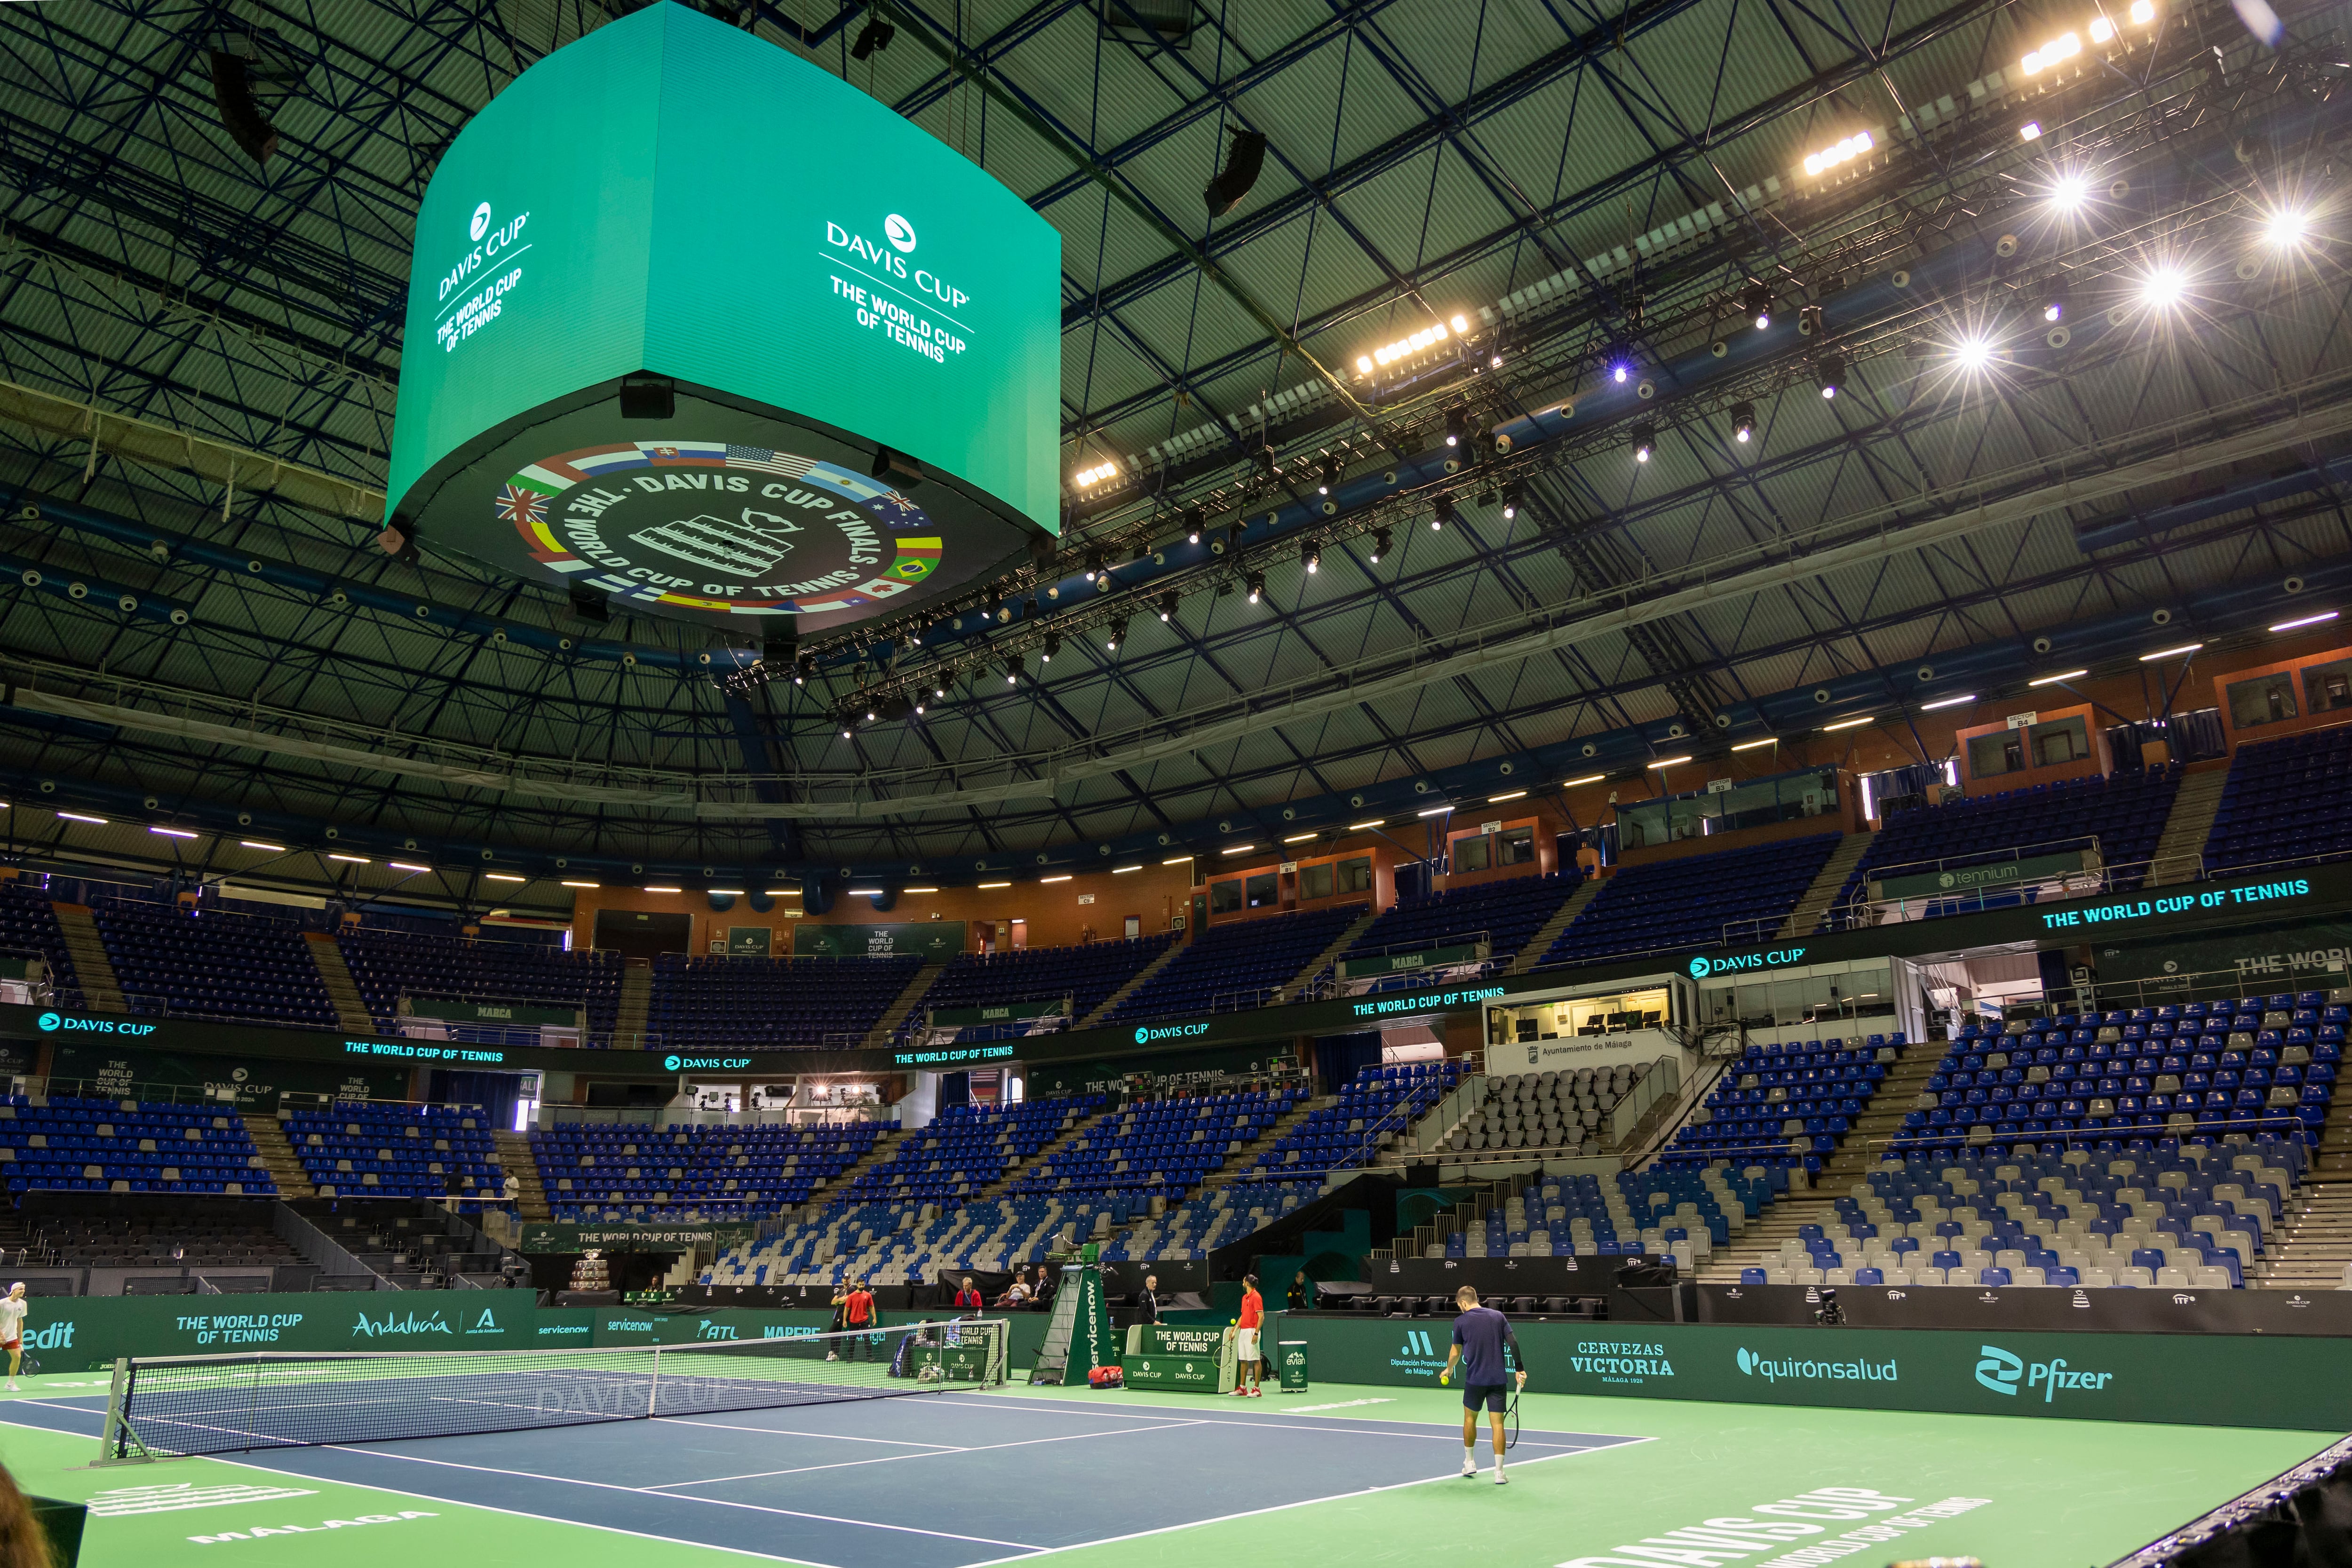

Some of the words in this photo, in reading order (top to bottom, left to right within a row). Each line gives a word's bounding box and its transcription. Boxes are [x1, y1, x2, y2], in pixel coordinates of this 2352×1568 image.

[439, 246, 482, 301] DAVIS
[486, 215, 527, 256] CUP
[826, 221, 907, 279] DAVIS
[914, 270, 967, 308] CUP
[437, 316, 455, 344] THE
[456, 286, 493, 326] WORLD
[496, 268, 522, 297] CUP
[830, 275, 867, 307] THE
[871, 294, 931, 338] WORLD
[935, 328, 966, 354] CUP
[446, 328, 460, 352] OF
[461, 299, 502, 340] TENNIS
[857, 308, 880, 329] OF
[884, 319, 944, 363] TENNIS
[567, 488, 627, 517] THE
[632, 474, 750, 493] DAVIS
[762, 483, 834, 509] CUP
[825, 510, 881, 565] FINALS
[564, 518, 630, 567] WORLD
[627, 567, 693, 588] CUP
[752, 570, 860, 597] TENNIS
[702, 584, 744, 596] OF
[2010, 712, 2034, 721] SECTOR
[1956, 866, 2018, 883] tennium
[2042, 911, 2081, 928] THE
[2083, 902, 2151, 923] WORLD
[2155, 896, 2194, 914] CUP
[2201, 890, 2226, 907] OF
[2230, 879, 2309, 904] TENNIS
[1392, 955, 1424, 969] MARCA
[1713, 954, 1762, 971] DAVIS
[1767, 948, 1803, 964] CUP
[2233, 955, 2284, 976] THE
[2287, 947, 2352, 971] WORL
[1354, 1003, 1374, 1015] THE
[1377, 999, 1415, 1013] WORLD
[1419, 996, 1440, 1008] CUP
[1444, 993, 1458, 1004] OF
[1462, 987, 1504, 1002] TENNIS
[477, 1007, 511, 1019] MARCA
[983, 1008, 1009, 1019] MARCA
[64, 1018, 114, 1033] DAVIS
[118, 1023, 155, 1035] CUP
[1151, 1027, 1182, 1039] DAVIS
[1185, 1025, 1207, 1036] CUP
[345, 1042, 370, 1053] THE
[372, 1044, 414, 1057] WORLD
[417, 1047, 440, 1059] CUP
[442, 1049, 459, 1059] OF
[461, 1051, 504, 1062] TENNIS
[895, 1054, 913, 1063] THE
[916, 1052, 947, 1063] WORLD
[950, 1050, 967, 1060] CUP
[969, 1049, 980, 1059] OF
[982, 1046, 1012, 1057] TENNIS
[1543, 1045, 1591, 1056] Ayuntamiento
[1605, 1040, 1632, 1049] Málaga
[108, 1060, 127, 1069] THE
[683, 1058, 719, 1069] DAVIS
[723, 1058, 749, 1069] CUP
[99, 1069, 133, 1078] WORLD
[1085, 1081, 1106, 1092] THE
[1169, 1074, 1183, 1086] OF
[1185, 1069, 1224, 1083] TENNIS
[95, 1086, 131, 1095] TENNIS
[244, 1085, 273, 1094] CUP
[579, 1233, 599, 1242] THE
[641, 1233, 661, 1242] CUP
[664, 1233, 677, 1242] OF
[679, 1232, 712, 1242] TENNIS
[177, 1316, 208, 1329] THE
[213, 1315, 268, 1329] WORLD
[272, 1313, 302, 1327] CUP
[352, 1310, 453, 1337] Andalucía
[197, 1330, 219, 1344] OF
[223, 1329, 279, 1343] TENNIS
[707, 1327, 739, 1340] ATL
[1156, 1331, 1171, 1340] THE
[1173, 1331, 1201, 1341] WORLD
[1203, 1332, 1220, 1342] CUP
[1167, 1342, 1176, 1351] OF
[1178, 1342, 1208, 1352] TENNIS
[1578, 1342, 1664, 1356] CERVEZAS
[1413, 1368, 1433, 1376] Málaga
[1571, 1357, 1675, 1376] VICTORIA
[1759, 1359, 1897, 1383] quirónsalud
[2028, 1358, 2113, 1402] Pfizer
[534, 1385, 645, 1419] DAVIS
[660, 1376, 732, 1407] CUP
[1752, 1487, 1915, 1519] CUP
[1903, 1497, 1993, 1518] TENNIS
[187, 1510, 440, 1544] MÁLAGA
[1880, 1515, 1935, 1527] OF
[1839, 1525, 1908, 1541] CUP
